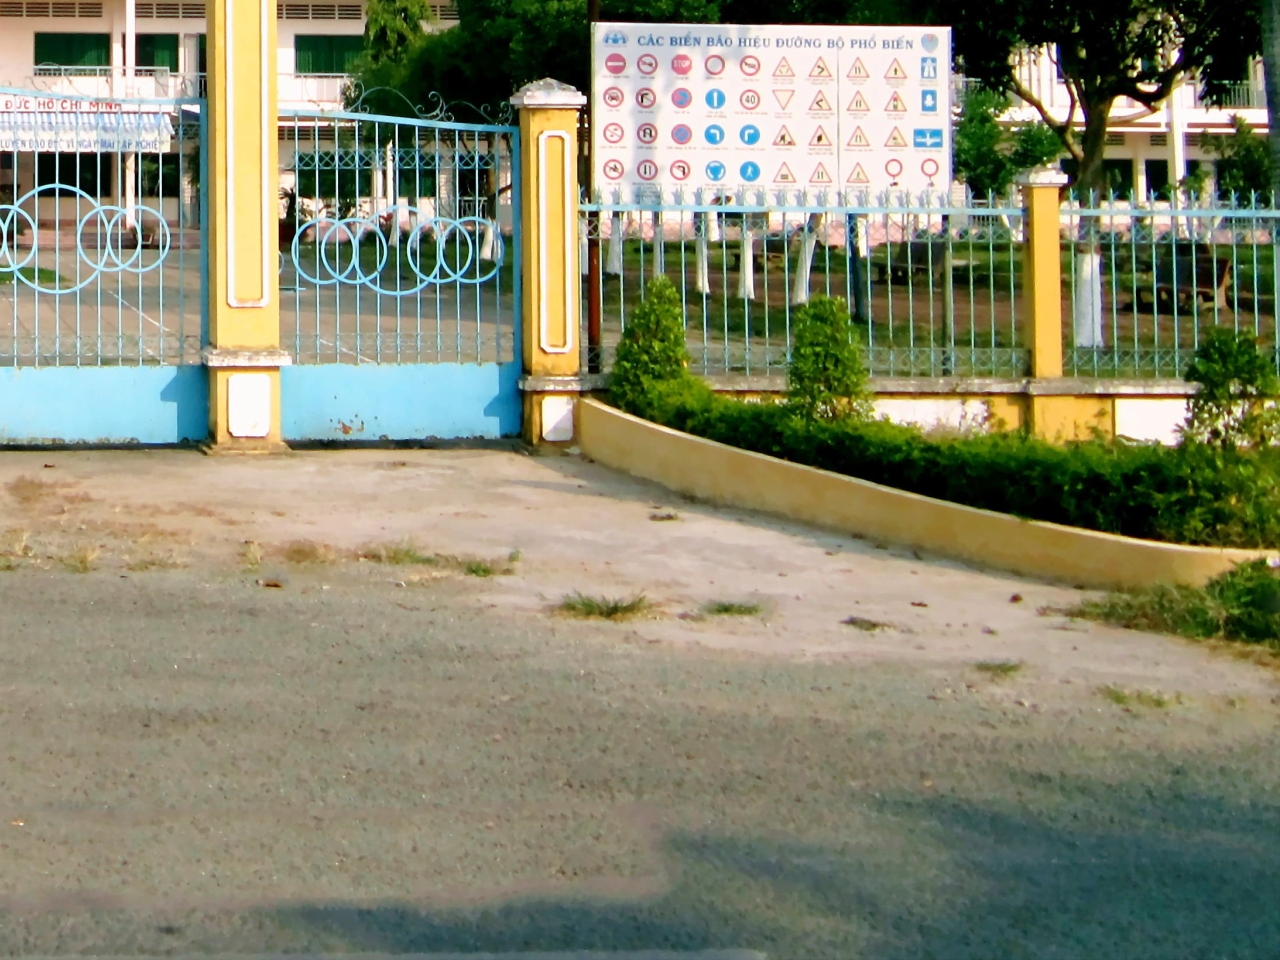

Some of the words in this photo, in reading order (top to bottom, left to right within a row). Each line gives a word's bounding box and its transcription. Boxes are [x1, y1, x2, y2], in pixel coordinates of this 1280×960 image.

[637, 34, 664, 47] CÁC
[827, 37, 845, 50] BỘ
[673, 60, 691, 68] STOP
[745, 95, 756, 105] 40
